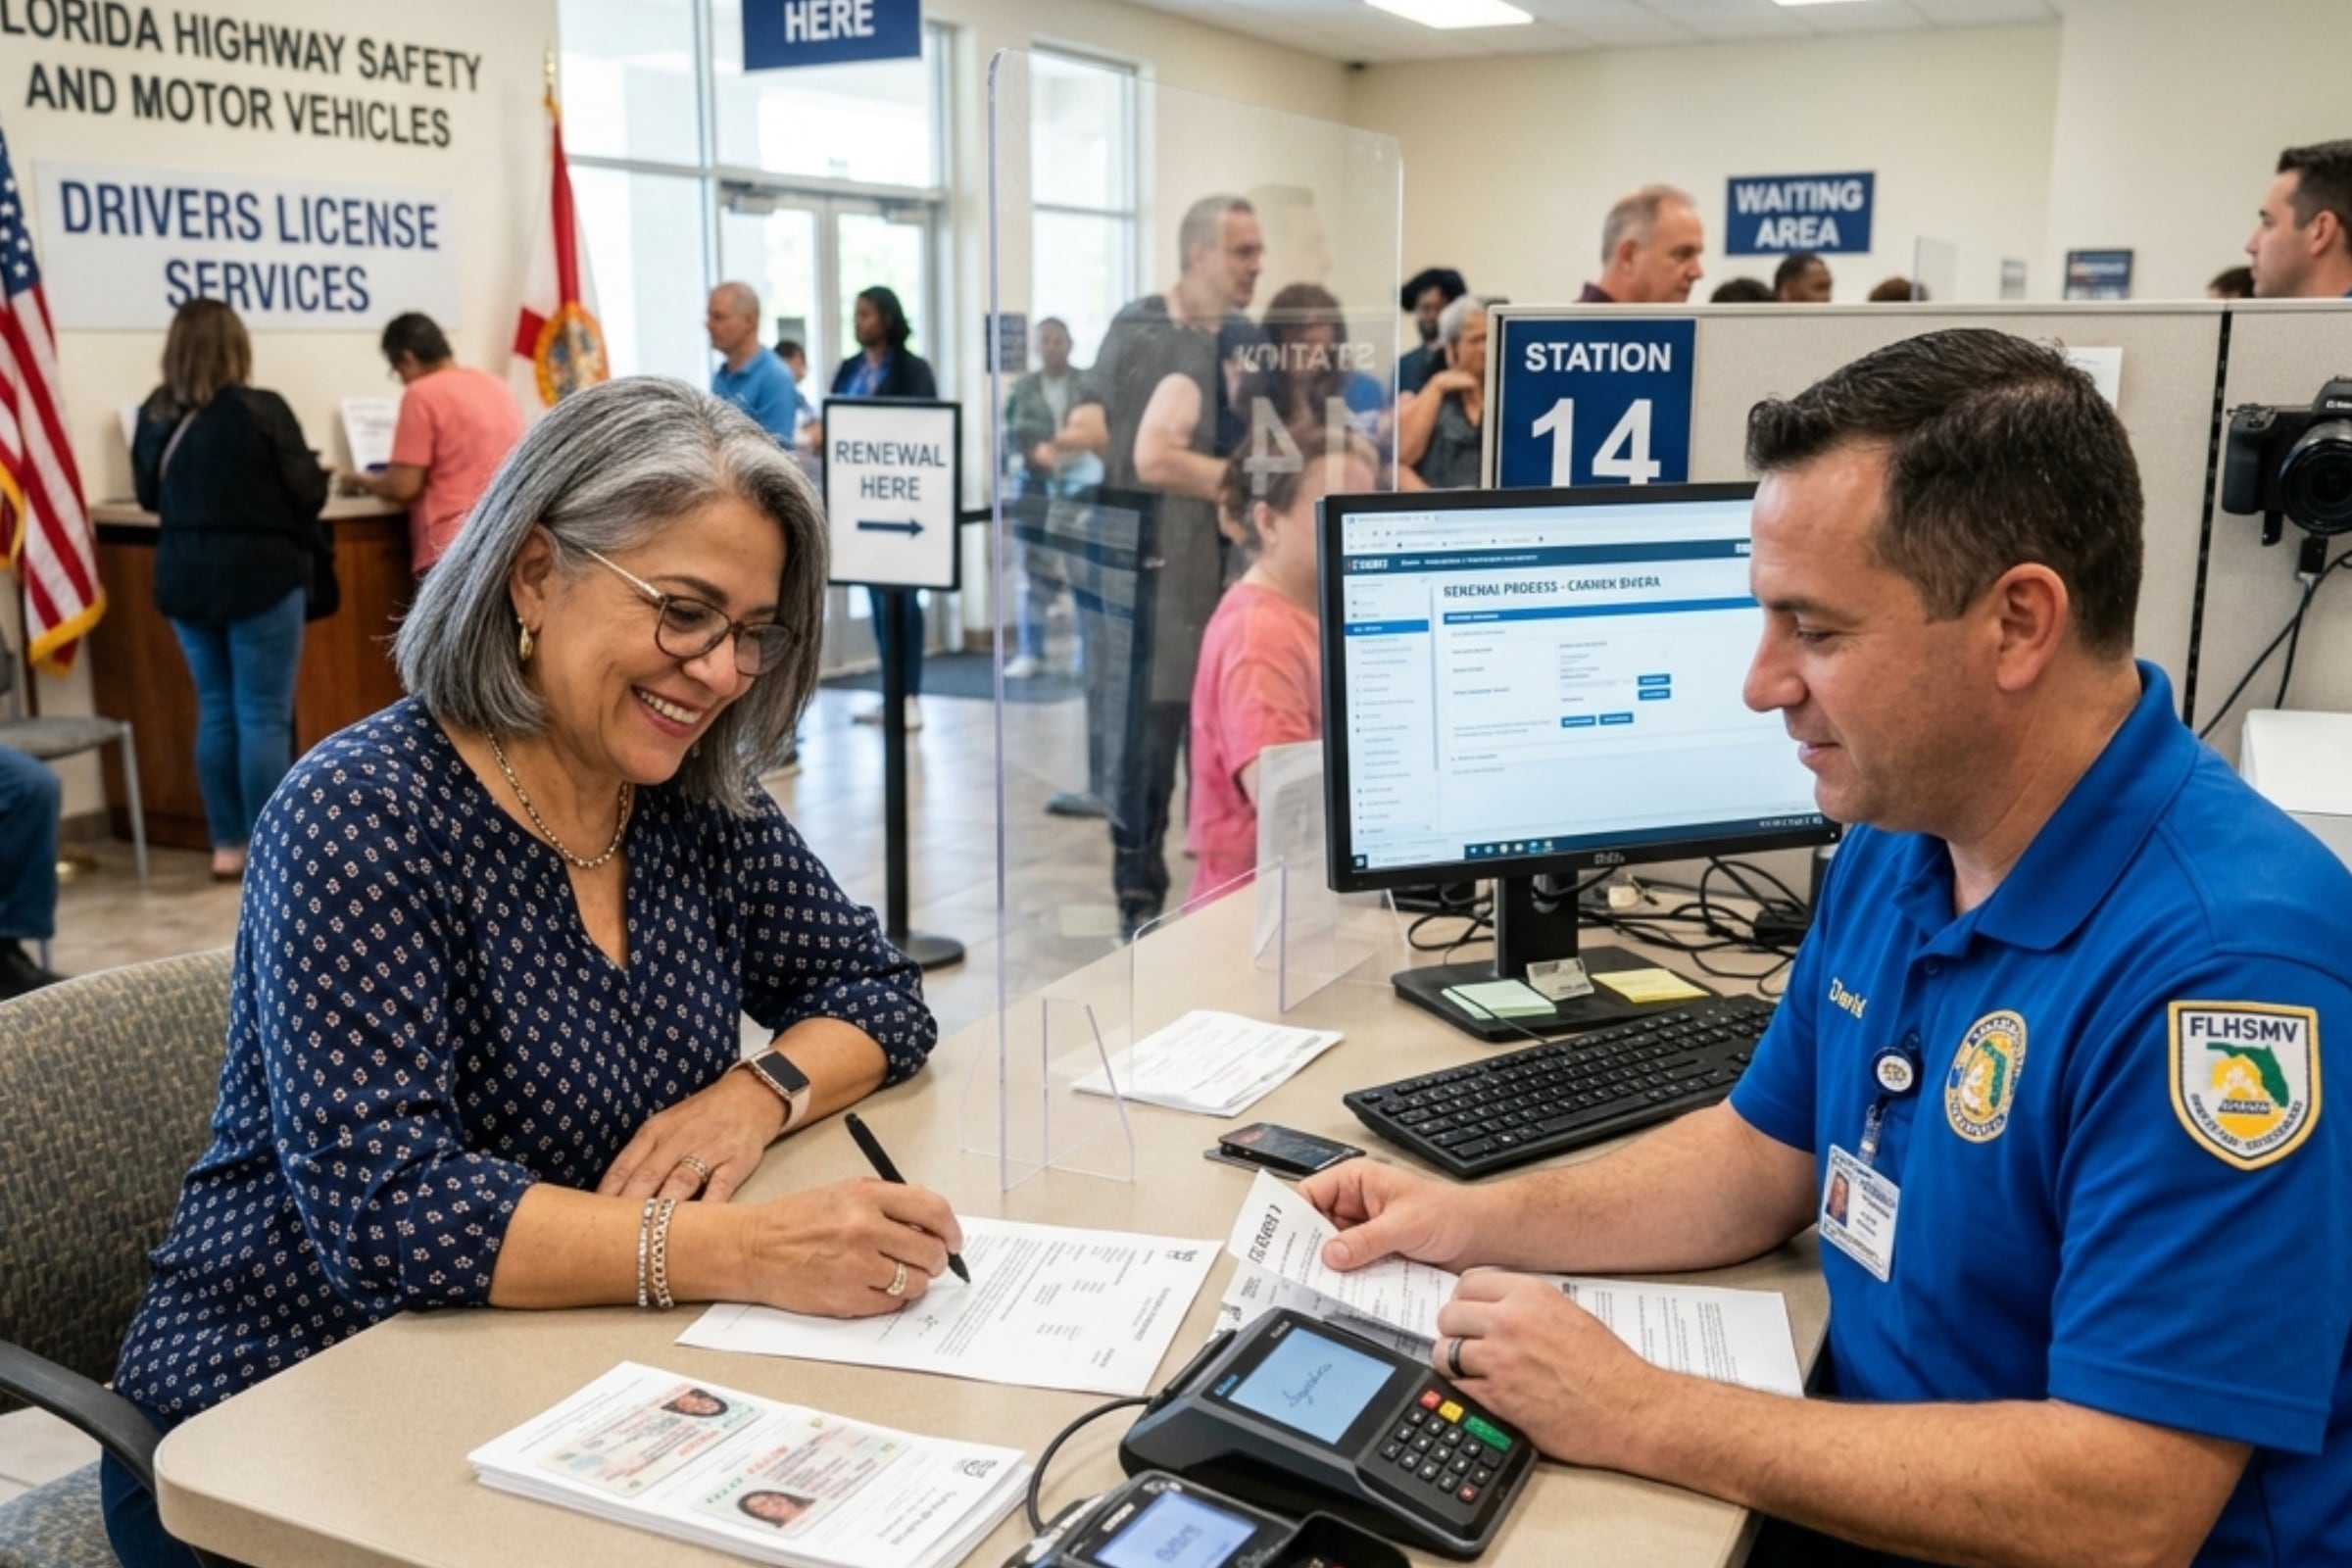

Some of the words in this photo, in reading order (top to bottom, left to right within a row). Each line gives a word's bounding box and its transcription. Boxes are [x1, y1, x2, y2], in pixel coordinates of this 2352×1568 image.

[785, 0, 875, 43] HERE
[173, 11, 345, 74] HIGHWAY
[358, 37, 480, 91] SAFETY
[26, 63, 116, 114] AND
[131, 74, 274, 130] MOTOR
[284, 90, 451, 148] VEHICLES
[1735, 179, 1864, 214] WAITING
[60, 181, 262, 242] DRIVERS
[276, 194, 439, 250] LICENSE
[1754, 217, 1840, 248] AREA
[1525, 342, 1671, 372] STATION
[835, 441, 946, 467] RENEWAL
[1532, 397, 1661, 487] 14
[860, 475, 920, 501] HERE
[2190, 1016, 2298, 1043] FLHSMV
